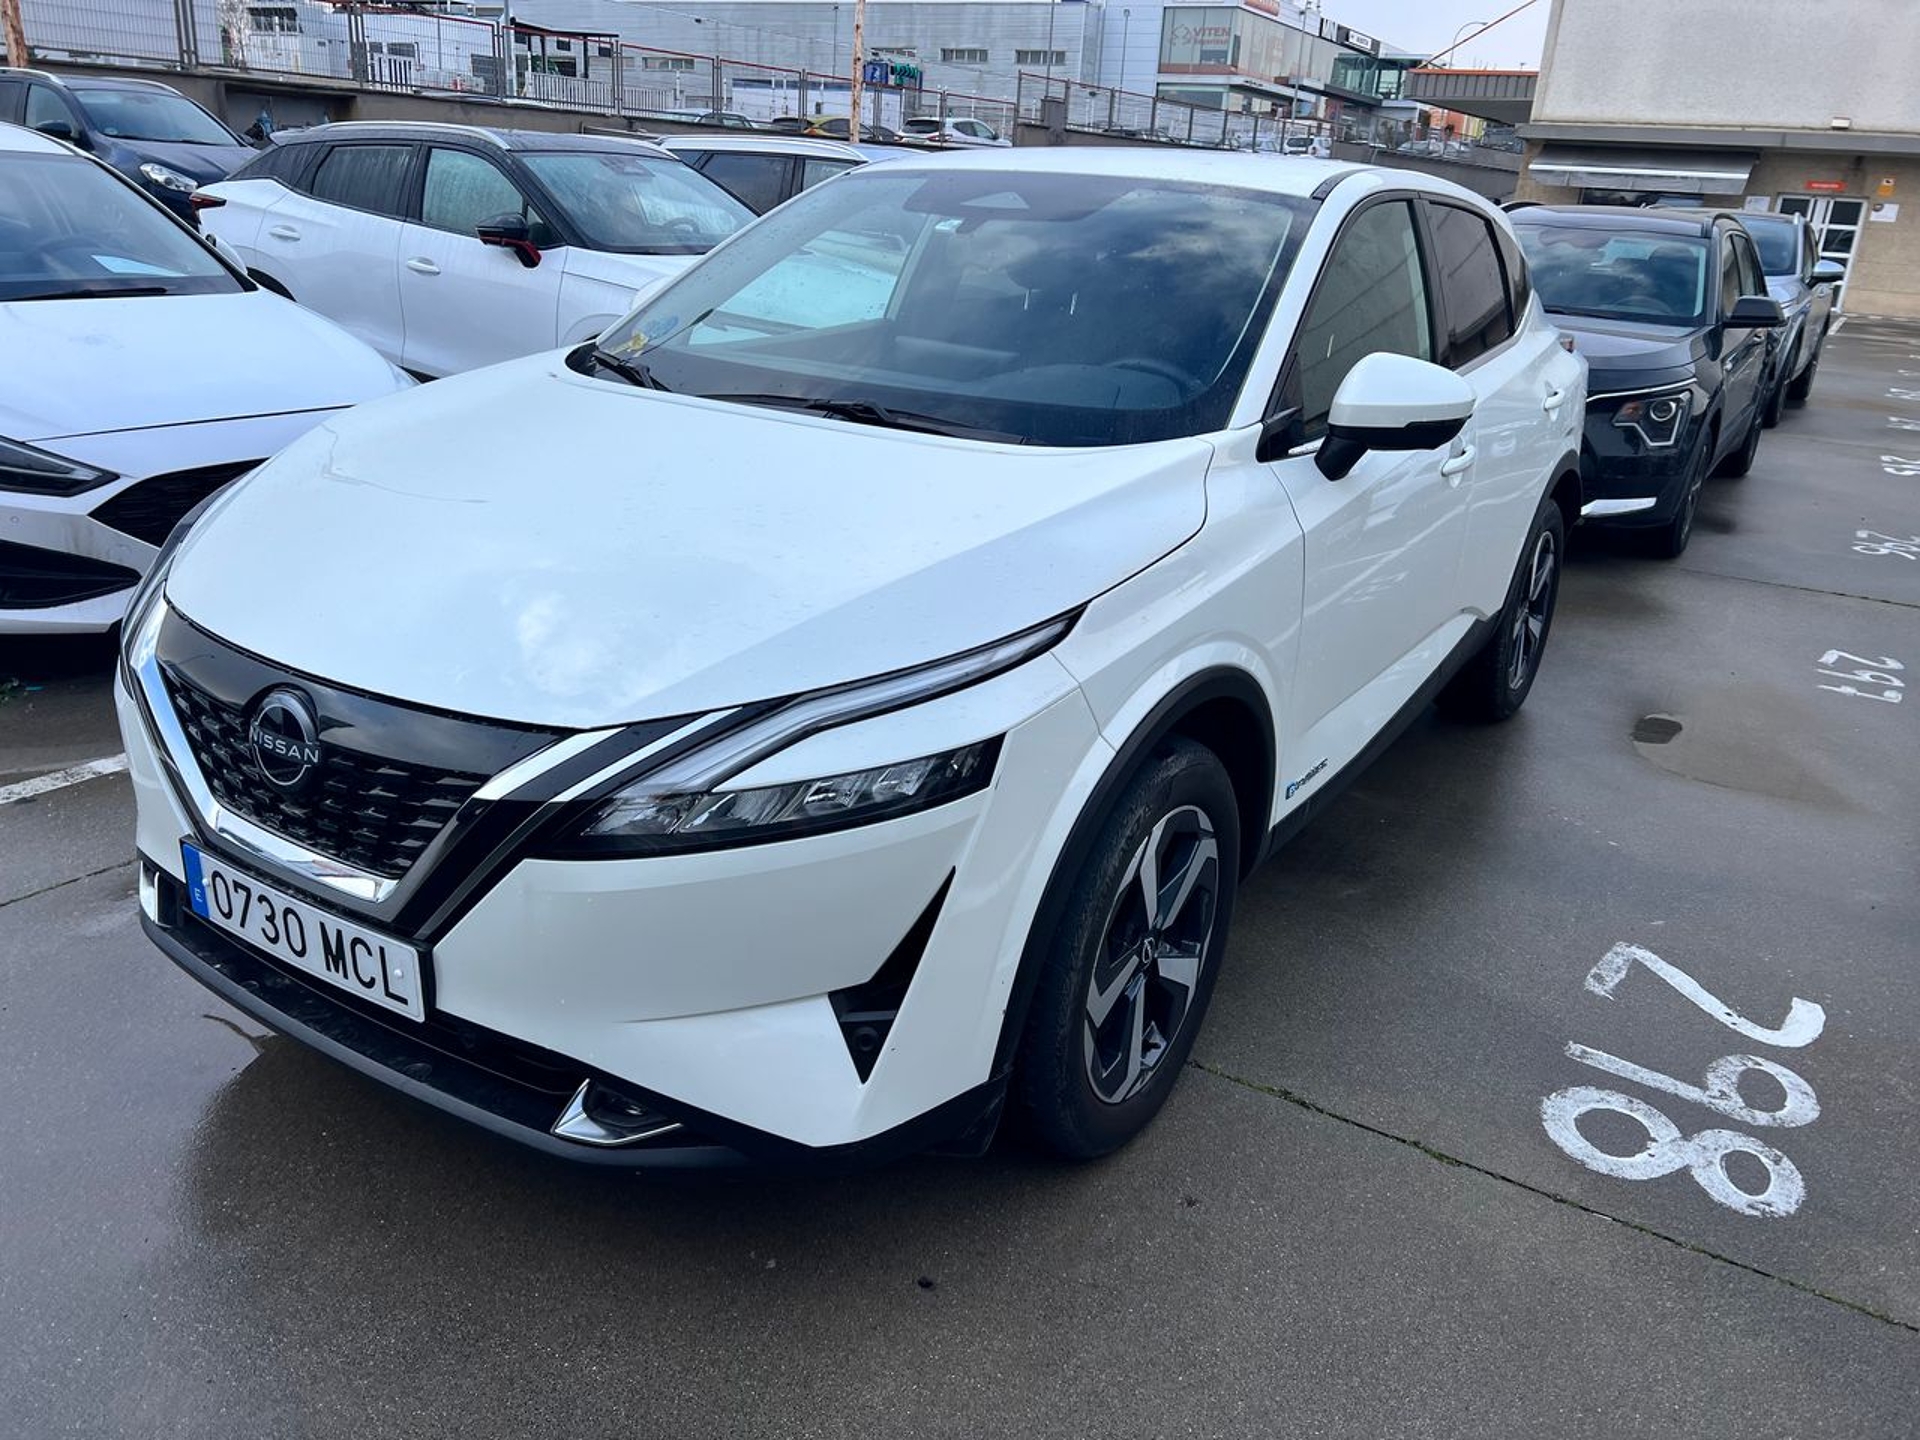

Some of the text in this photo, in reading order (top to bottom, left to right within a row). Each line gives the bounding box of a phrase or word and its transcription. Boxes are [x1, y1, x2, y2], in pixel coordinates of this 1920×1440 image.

[1193, 26, 1231, 37] VITEN
[251, 724, 319, 763] NISSAN
[194, 887, 203, 903] E
[210, 869, 408, 1006] 0730 MCL
[1541, 941, 1827, 1218] 298
